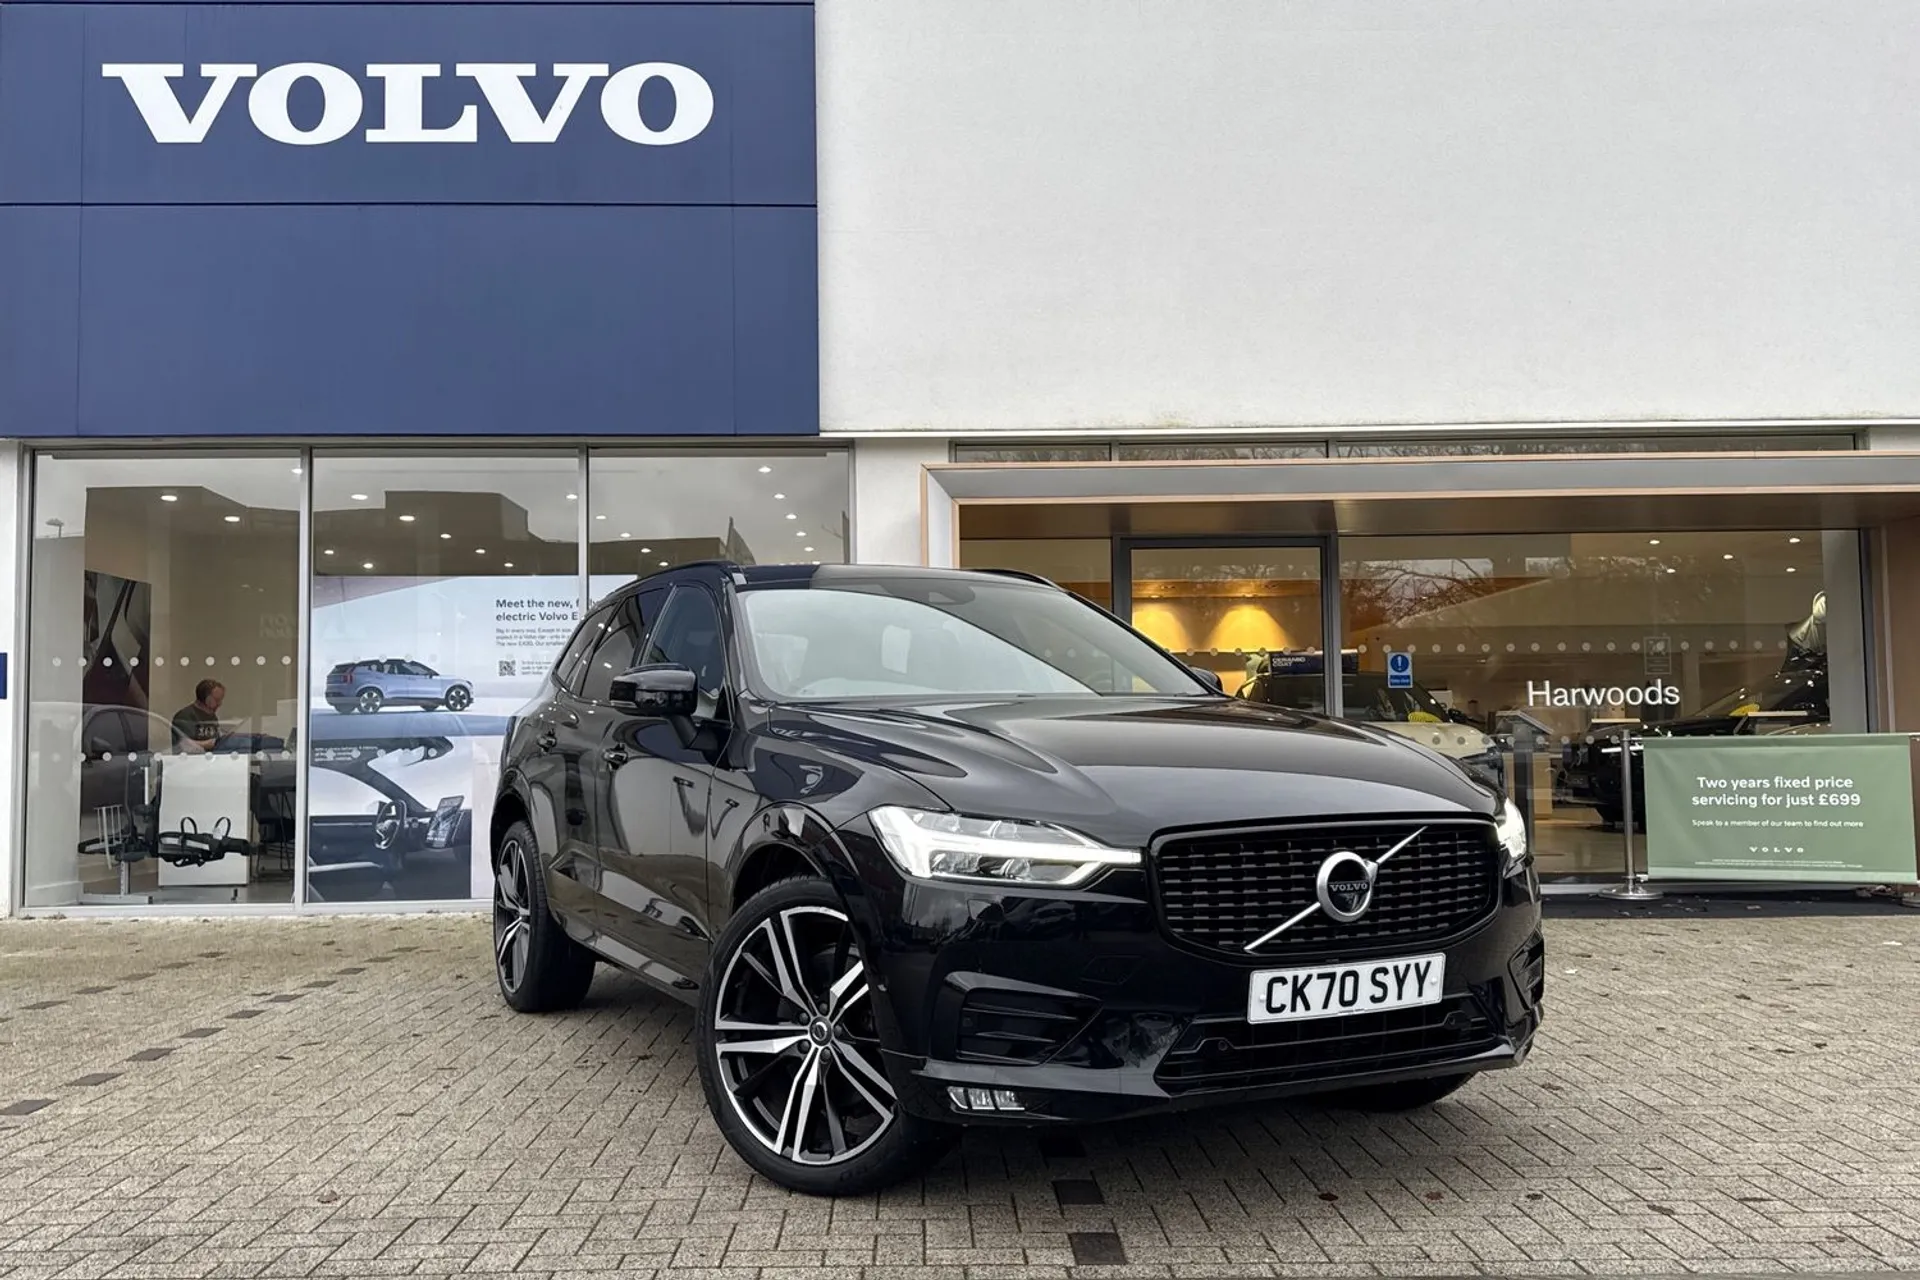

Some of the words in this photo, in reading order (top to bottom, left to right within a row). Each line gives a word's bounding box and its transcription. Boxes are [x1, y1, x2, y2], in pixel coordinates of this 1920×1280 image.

[102, 62, 714, 146] VOLVO
[496, 599, 524, 608] Meet
[527, 599, 545, 608] the
[547, 600, 573, 609] new,
[496, 612, 536, 621] electric
[539, 612, 568, 621] Volvo
[1527, 678, 1681, 707] Harwoods
[1697, 776, 1727, 789] Two
[1731, 779, 1770, 791] years
[1774, 775, 1810, 789] fixed
[1815, 776, 1853, 791] price
[1692, 793, 1757, 808] servicing
[1761, 793, 1782, 806] for
[1786, 794, 1814, 808] just
[1818, 793, 1861, 806] £699
[1692, 819, 1713, 828] Speak
[1730, 819, 1760, 827] member
[1770, 819, 1782, 827] our
[1784, 819, 1803, 827] team
[1814, 819, 1828, 827] find
[1829, 819, 1842, 827] out
[1844, 819, 1864, 827] more
[1329, 883, 1368, 893] VOLVO
[1266, 970, 1359, 1014] CK70
[1370, 961, 1431, 1004] SYY
